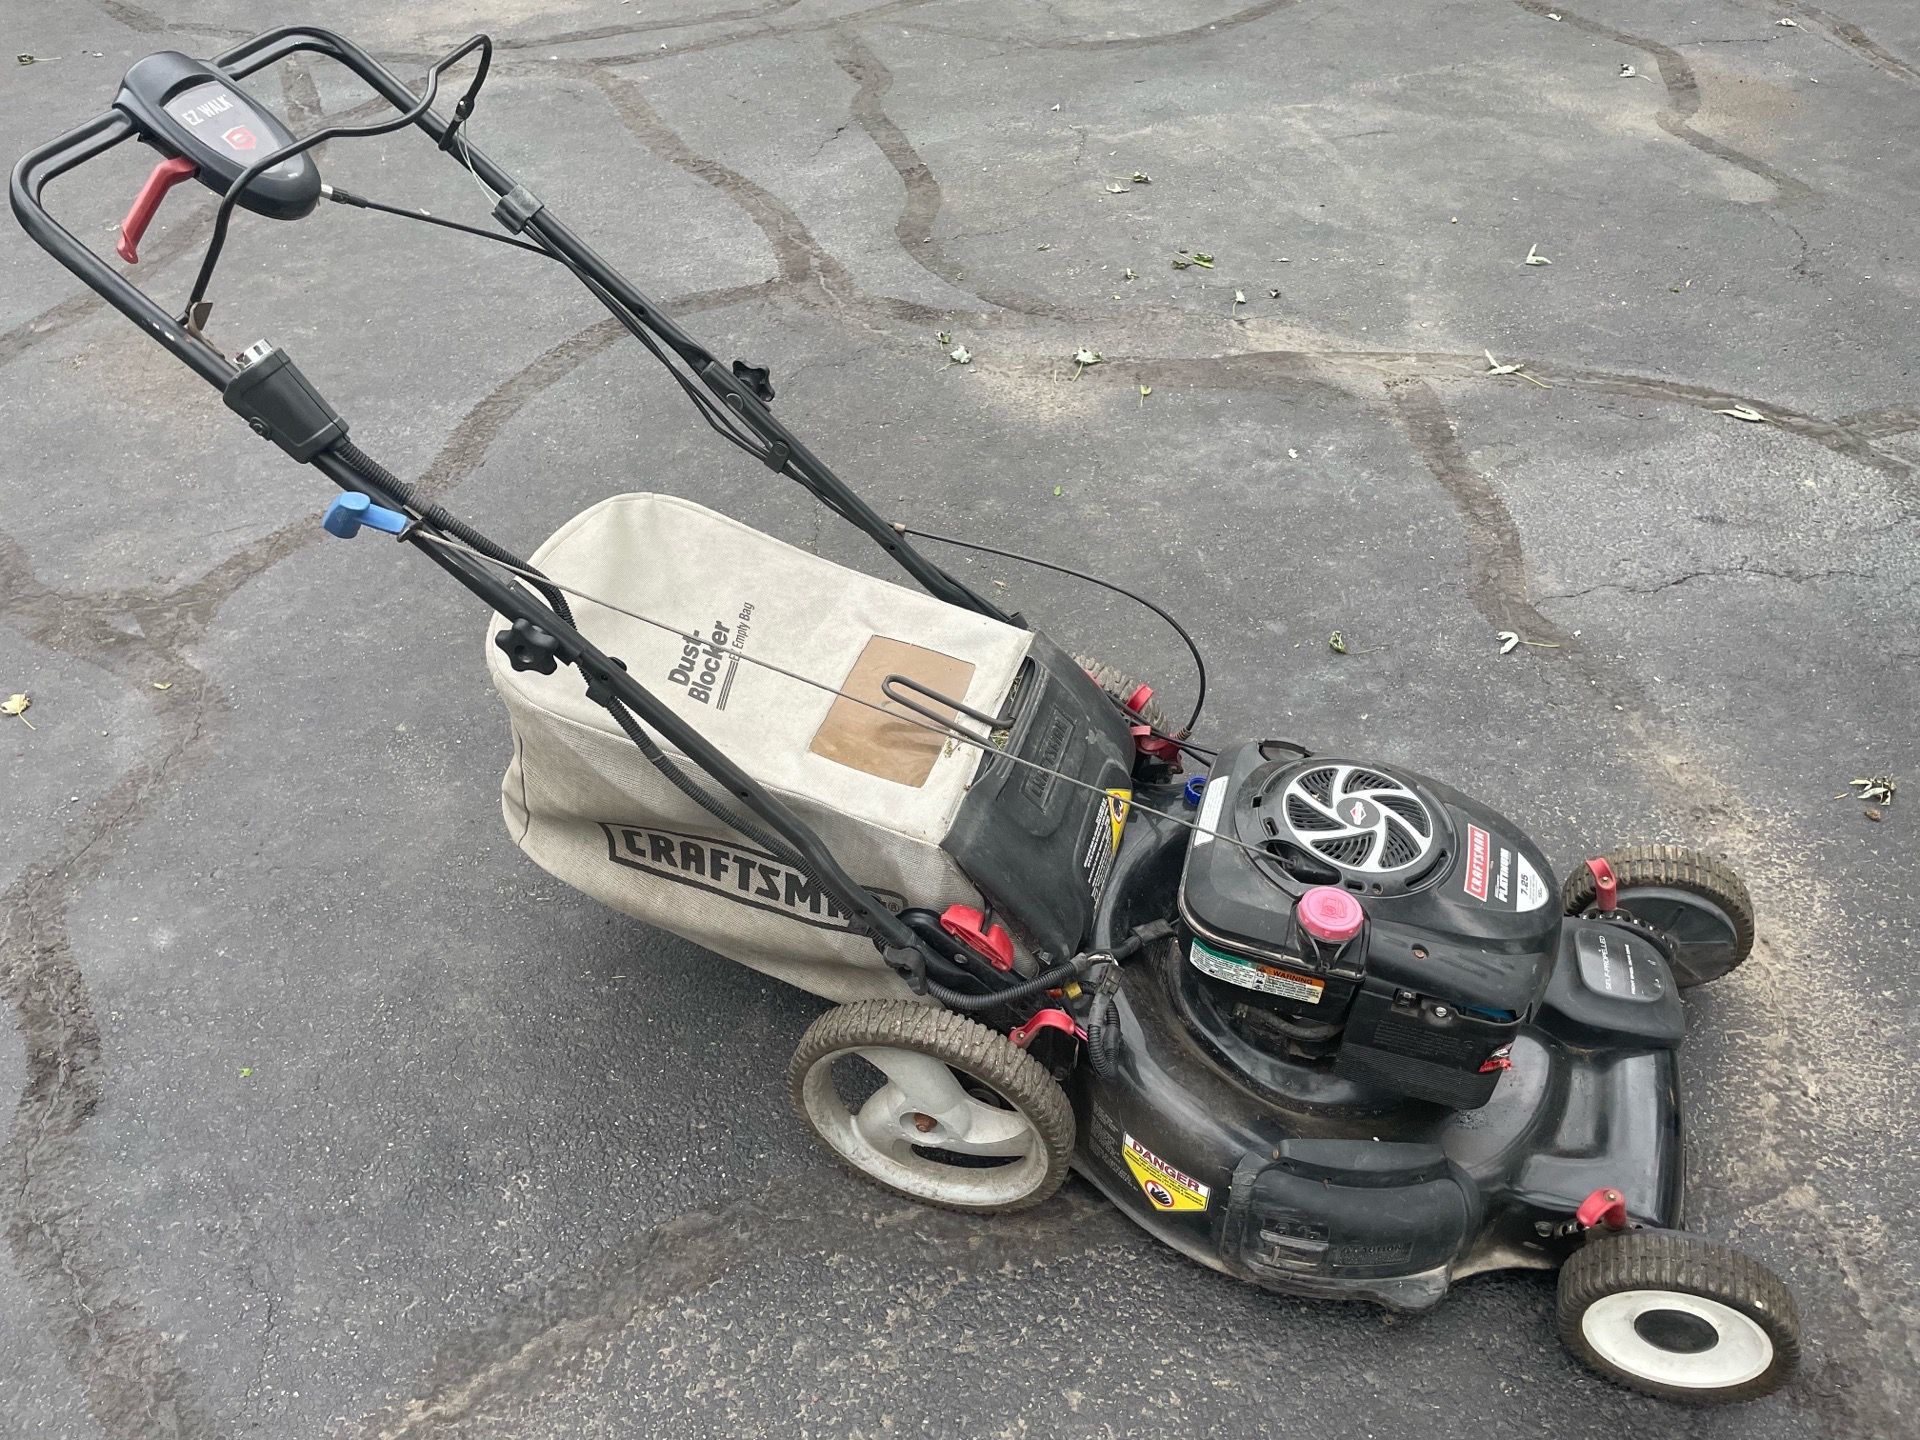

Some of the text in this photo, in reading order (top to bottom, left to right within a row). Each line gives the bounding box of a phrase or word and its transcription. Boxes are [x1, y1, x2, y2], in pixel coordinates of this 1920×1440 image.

[181, 94, 234, 126] EZ WALK
[731, 621, 751, 650] Empty
[738, 601, 755, 622] Bag
[667, 629, 702, 687] Dust-
[687, 620, 730, 705] Blocker
[620, 829, 887, 921] CRAFTSM
[1470, 829, 1486, 894] CRAFTSMAN
[1498, 847, 1511, 903] PLATINUM
[1273, 969, 1314, 986] WARNING
[1598, 935, 1612, 991] SELF-PROPELLED
[1132, 1140, 1200, 1192] DANGER
